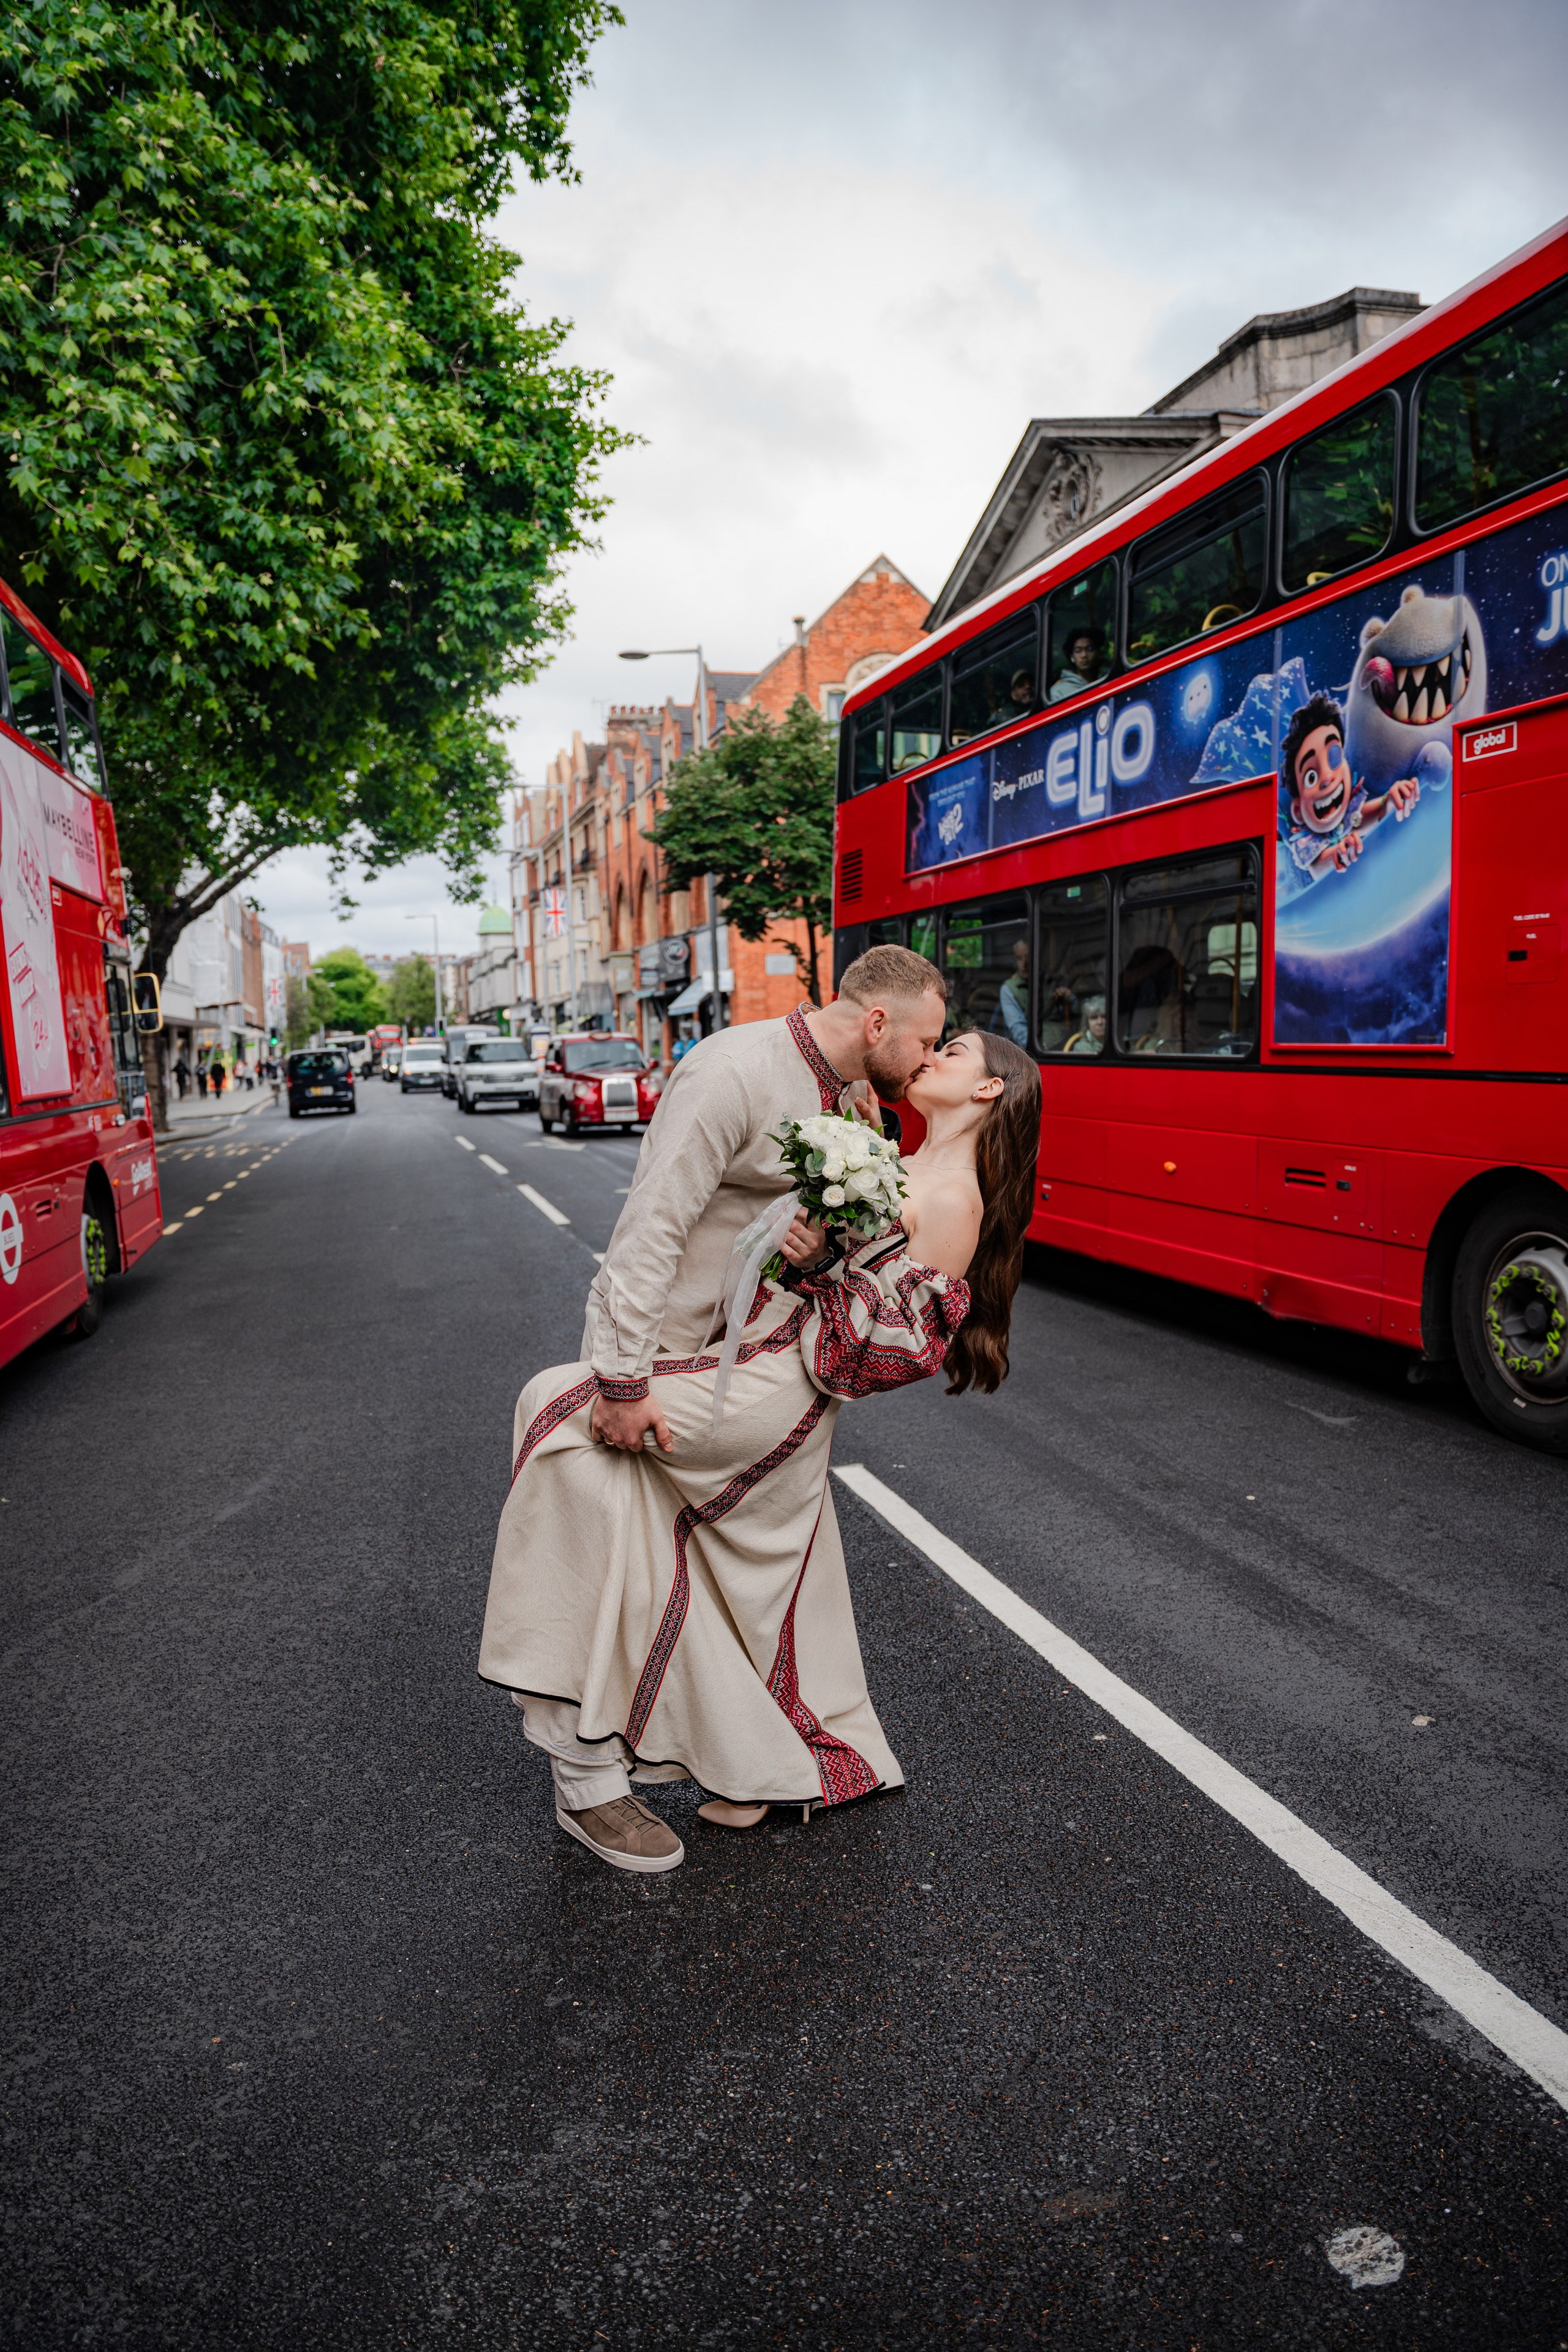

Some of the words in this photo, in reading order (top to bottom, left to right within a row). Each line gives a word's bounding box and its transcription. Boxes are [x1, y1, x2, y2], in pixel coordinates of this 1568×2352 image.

[1536, 585, 1568, 641] J
[1473, 728, 1506, 755] global
[42, 801, 96, 854] MAYBELLINE
